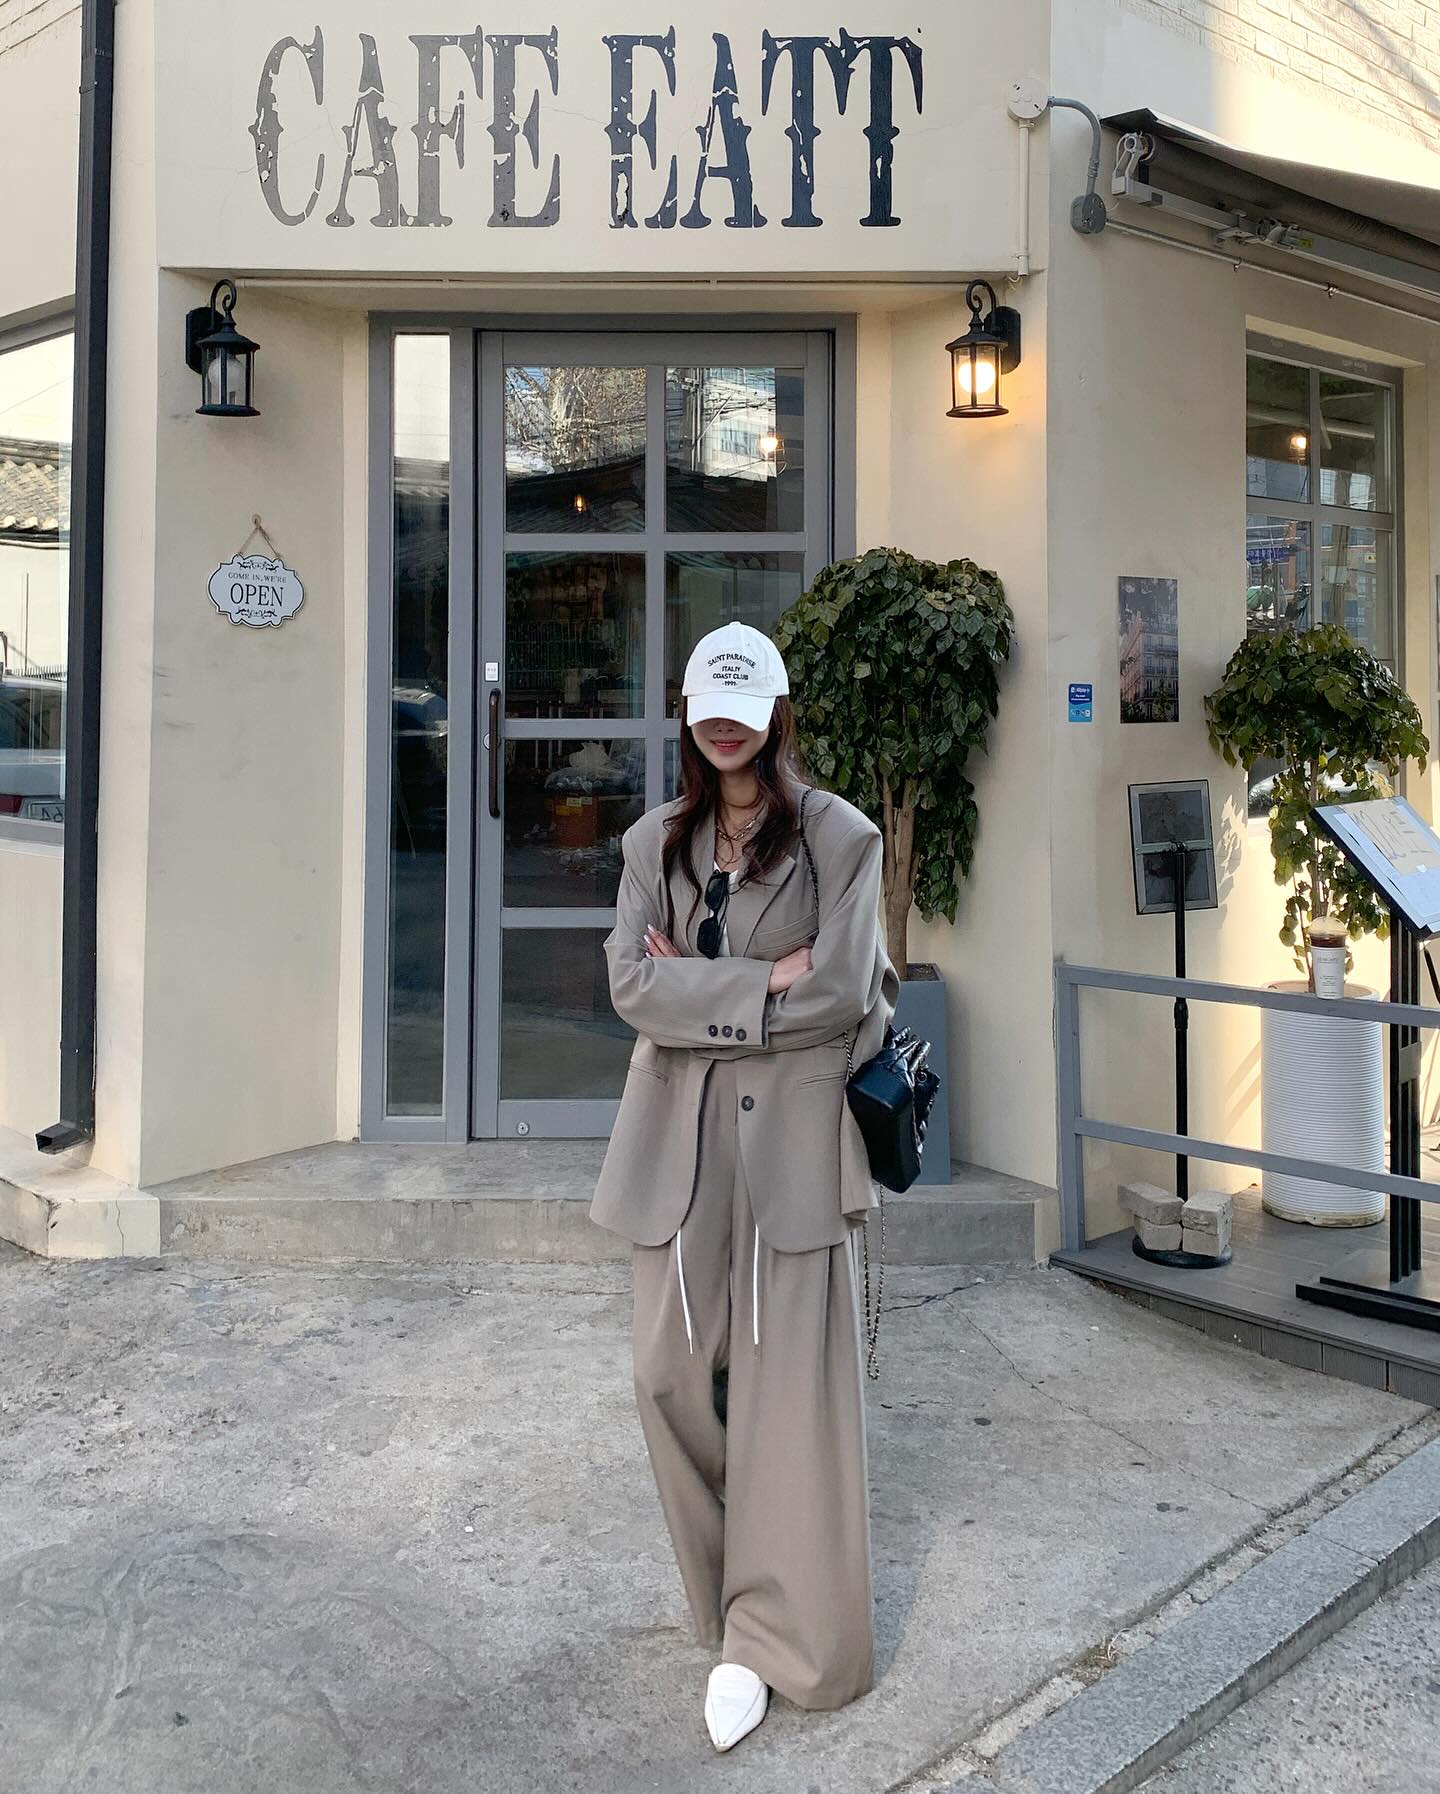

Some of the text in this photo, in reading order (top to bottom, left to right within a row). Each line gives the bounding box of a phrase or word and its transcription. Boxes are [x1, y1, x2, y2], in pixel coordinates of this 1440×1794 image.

[248, 25, 923, 228] CAFE EATT
[228, 572, 250, 580] COME
[230, 582, 284, 607] OPEN
[707, 653, 757, 669] SAINT PARADISE
[732, 673, 749, 681] CLUB
